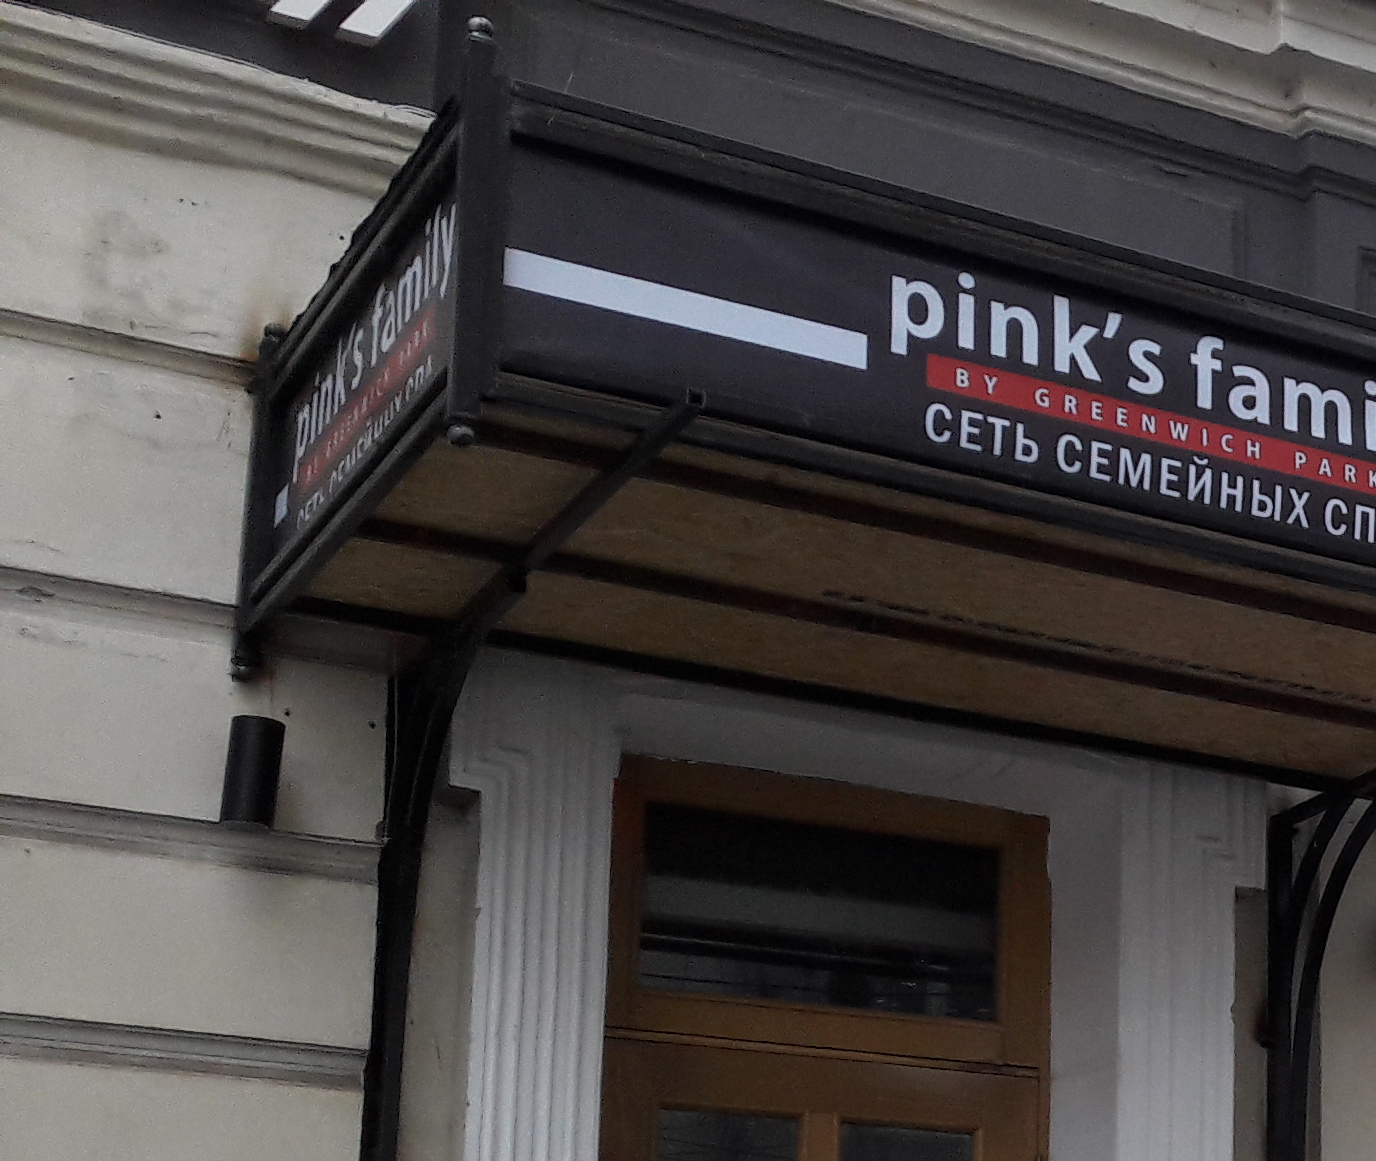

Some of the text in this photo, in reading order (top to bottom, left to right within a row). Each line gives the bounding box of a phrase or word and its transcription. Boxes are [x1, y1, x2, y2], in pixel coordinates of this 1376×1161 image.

[370, 202, 456, 368] family
[925, 402, 1039, 464] СЕТЬ
[1056, 433, 1310, 530] СЕМЕЙНЫХ
[955, 367, 998, 397] BY
[1034, 387, 1261, 461] GREENWICH
